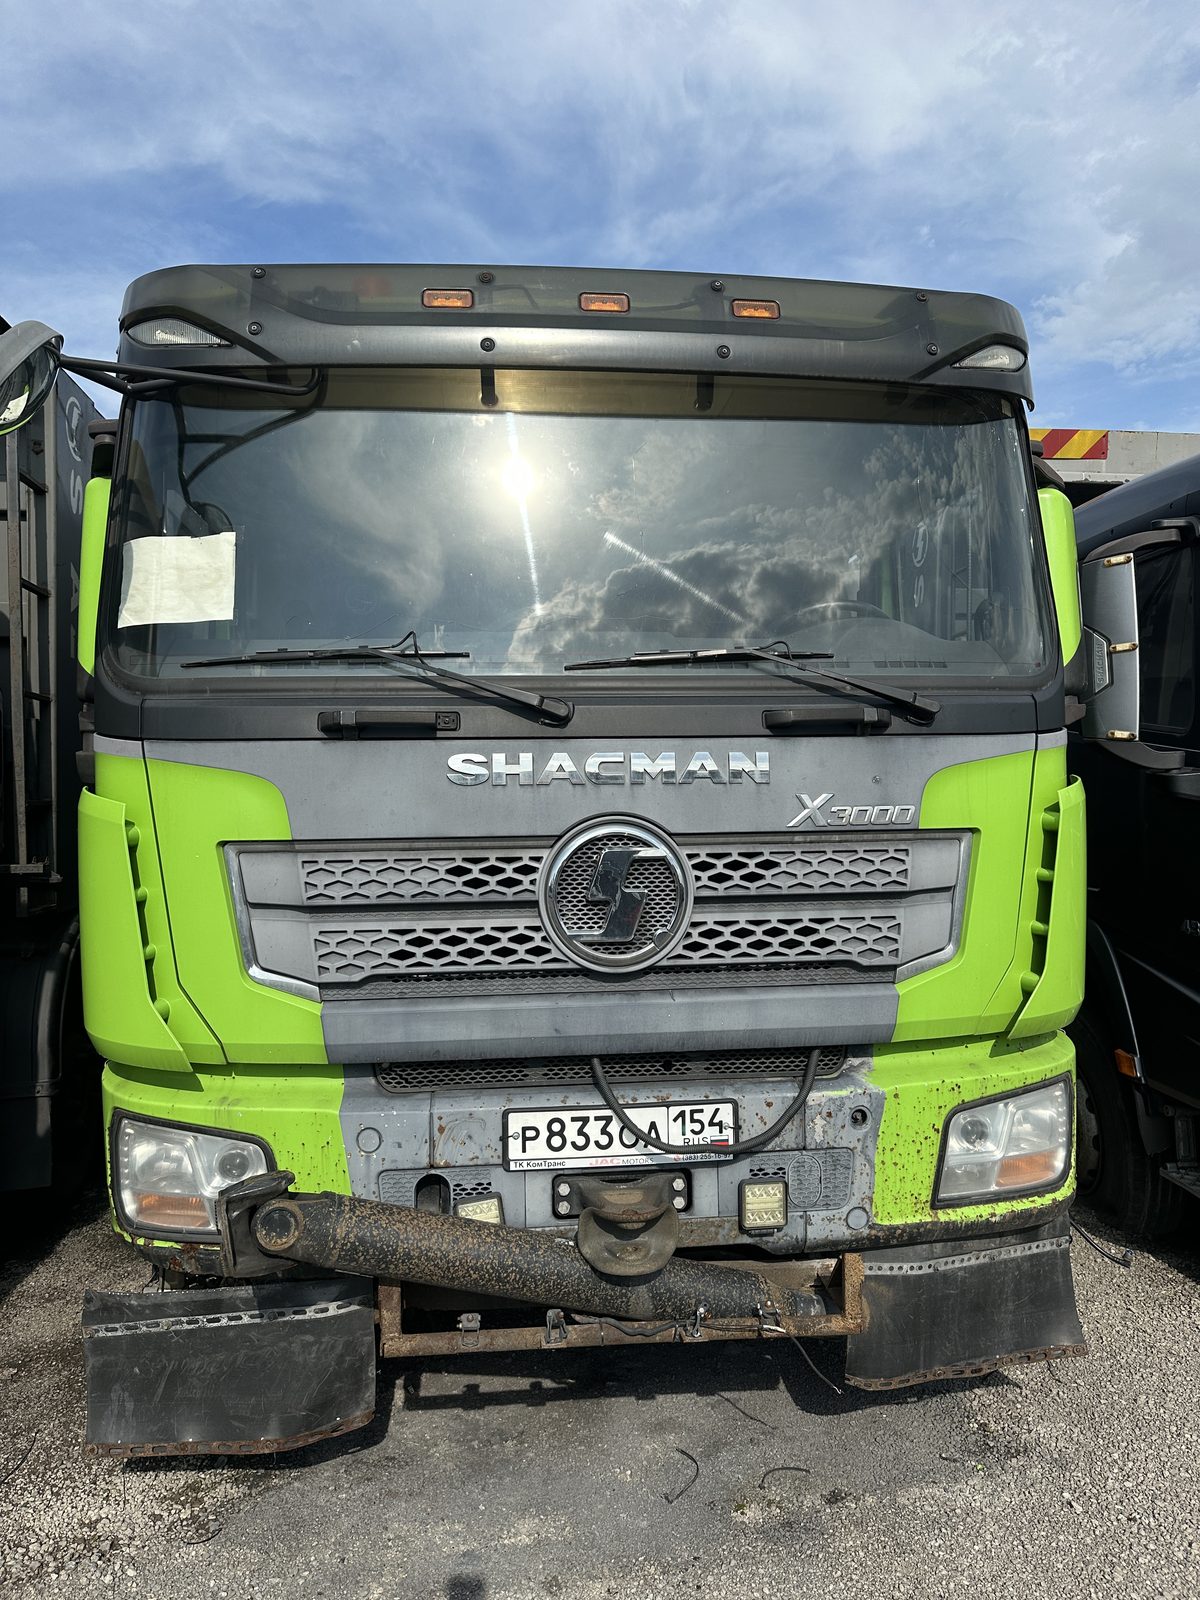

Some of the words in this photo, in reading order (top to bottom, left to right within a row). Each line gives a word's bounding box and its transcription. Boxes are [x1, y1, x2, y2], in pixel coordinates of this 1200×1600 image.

[446, 751, 771, 786] SHACMAN
[787, 792, 916, 828] X3000
[672, 1107, 723, 1136] 154
[683, 1137, 709, 1145] RUS
[526, 1160, 566, 1168] КомТранс
[589, 1158, 620, 1166] JAC
